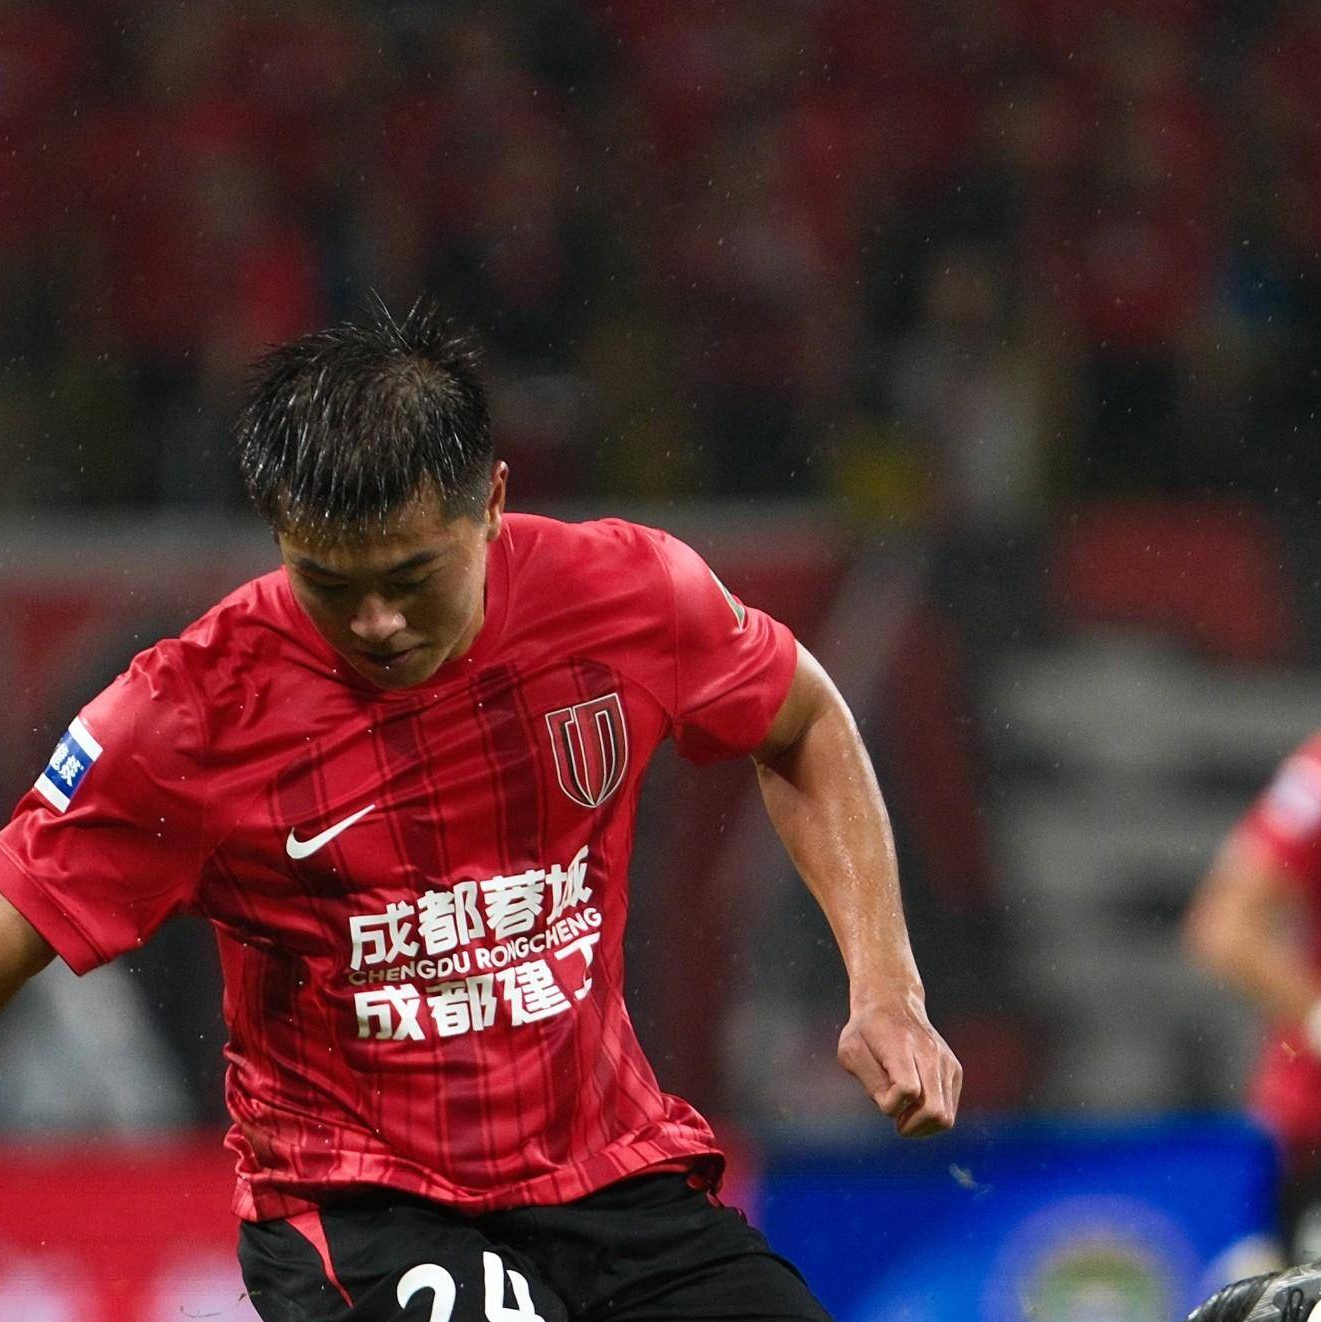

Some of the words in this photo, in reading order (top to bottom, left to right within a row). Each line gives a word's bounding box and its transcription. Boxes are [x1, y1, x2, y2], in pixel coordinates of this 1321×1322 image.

[348, 950, 471, 986] CHENGDU
[475, 907, 603, 971] RONGCHENG
[349, 844, 593, 972] 成都蓉城
